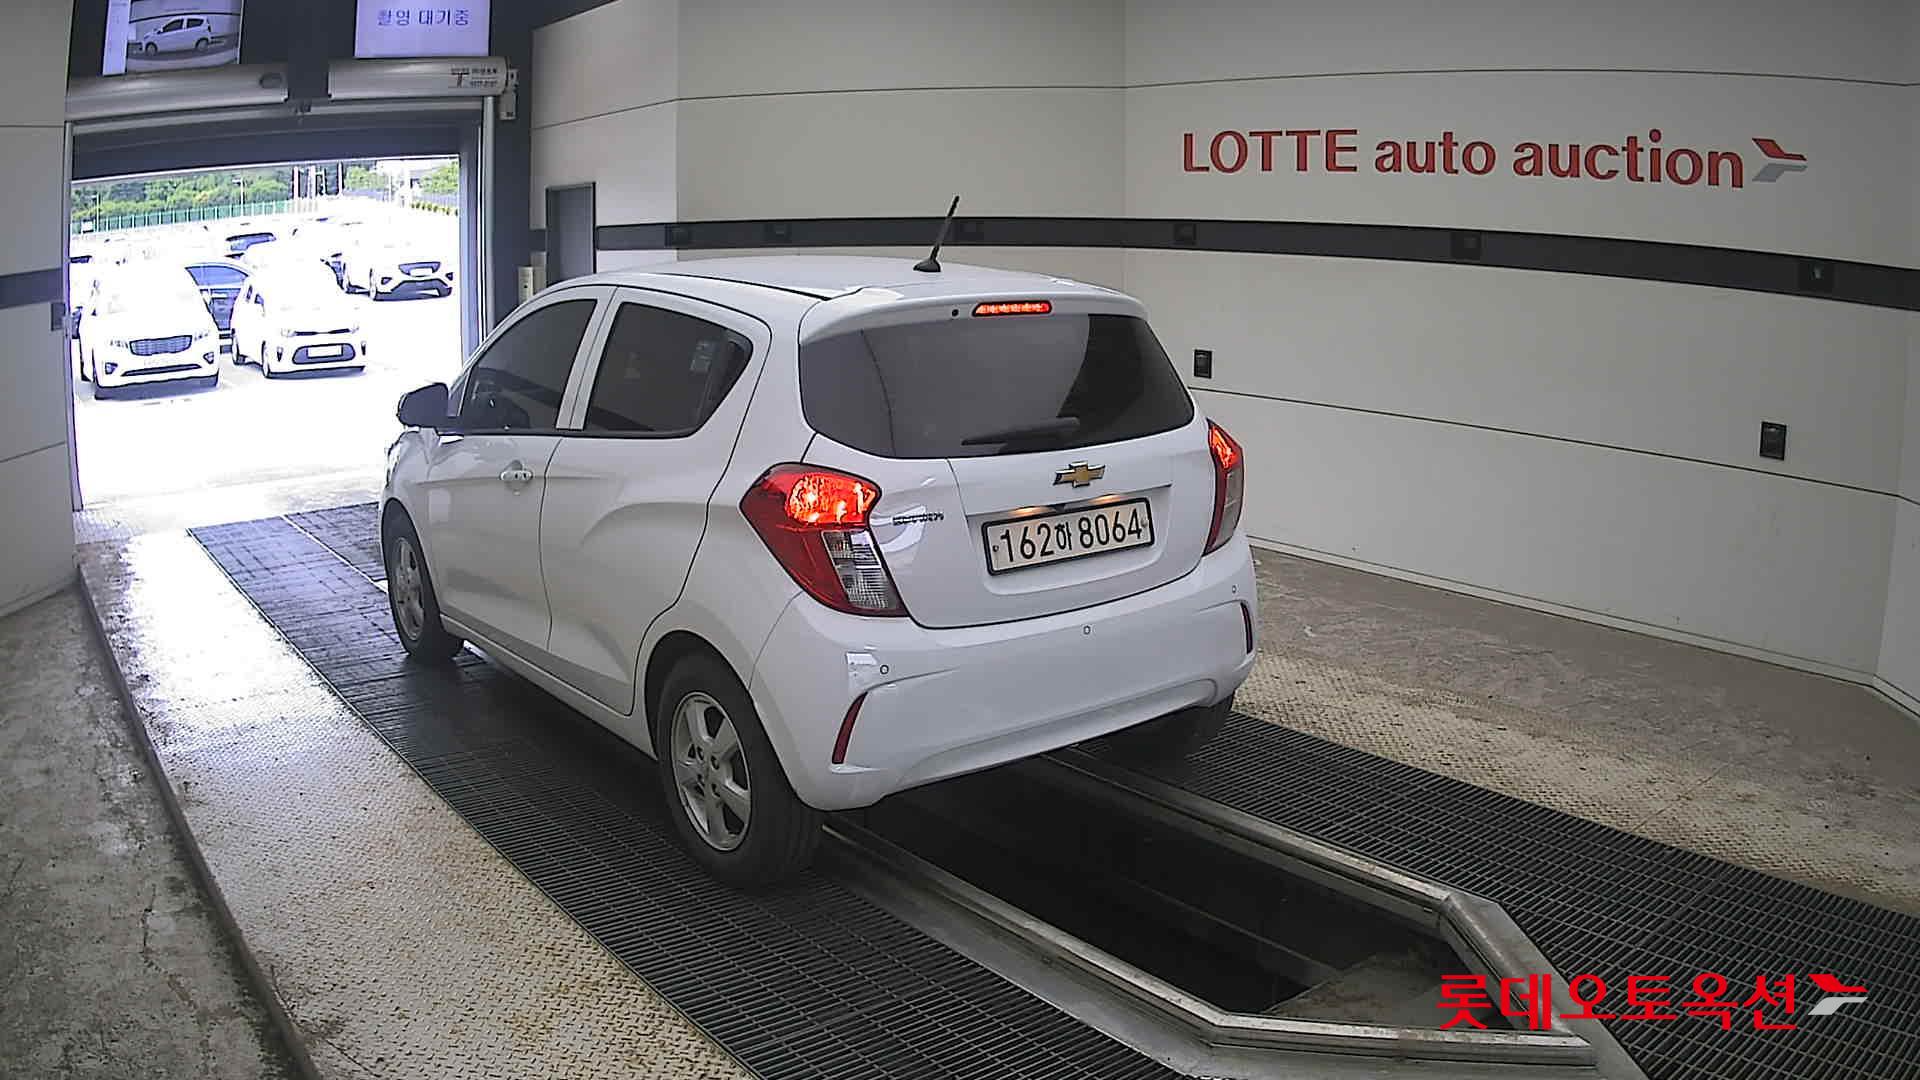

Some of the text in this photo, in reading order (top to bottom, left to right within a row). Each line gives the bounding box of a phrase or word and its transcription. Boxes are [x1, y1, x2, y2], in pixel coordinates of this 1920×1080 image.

[418, 9, 469, 26] 대기중
[1184, 129, 1744, 188] LOTTE auto auction
[1001, 508, 1142, 562] 162하 8064
